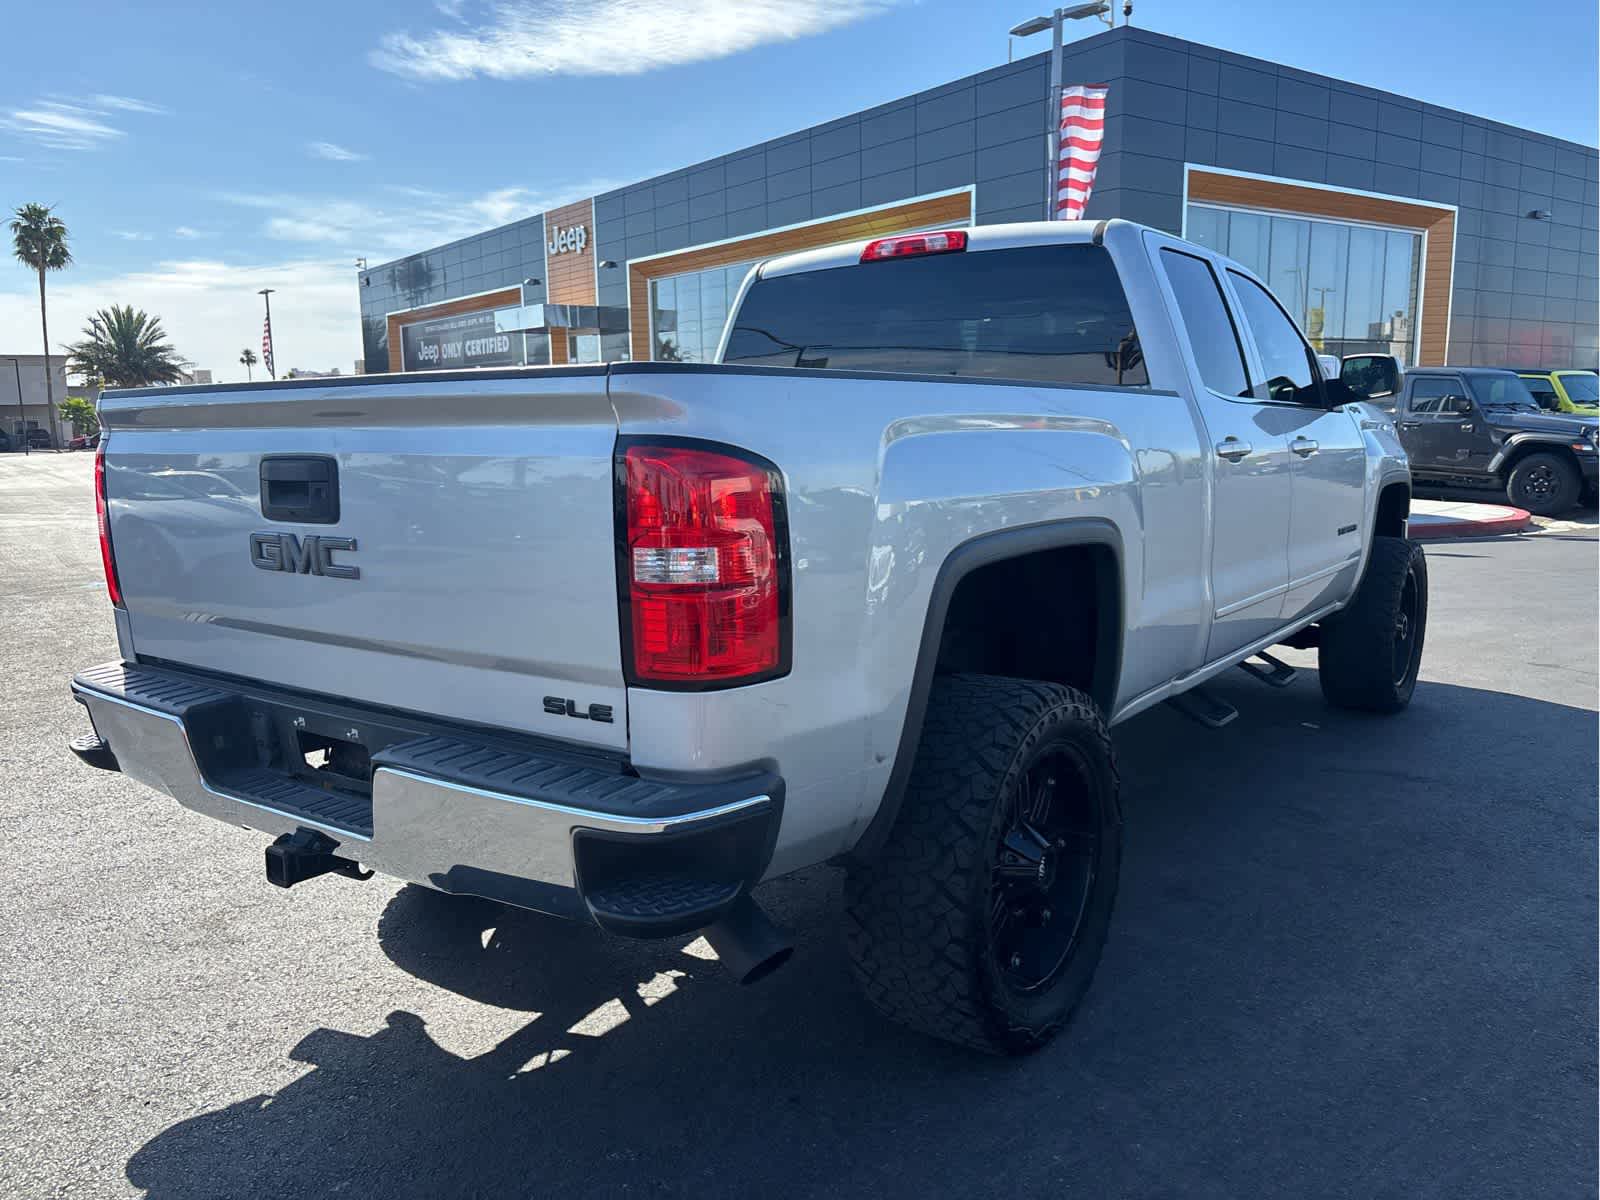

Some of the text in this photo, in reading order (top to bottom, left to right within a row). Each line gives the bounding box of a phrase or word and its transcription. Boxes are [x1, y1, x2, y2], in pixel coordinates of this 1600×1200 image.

[548, 225, 587, 255] Jeep
[418, 335, 510, 364] Jeep ONLY CERTIFIED
[250, 532, 360, 580] GMC
[543, 696, 614, 724] SLE
